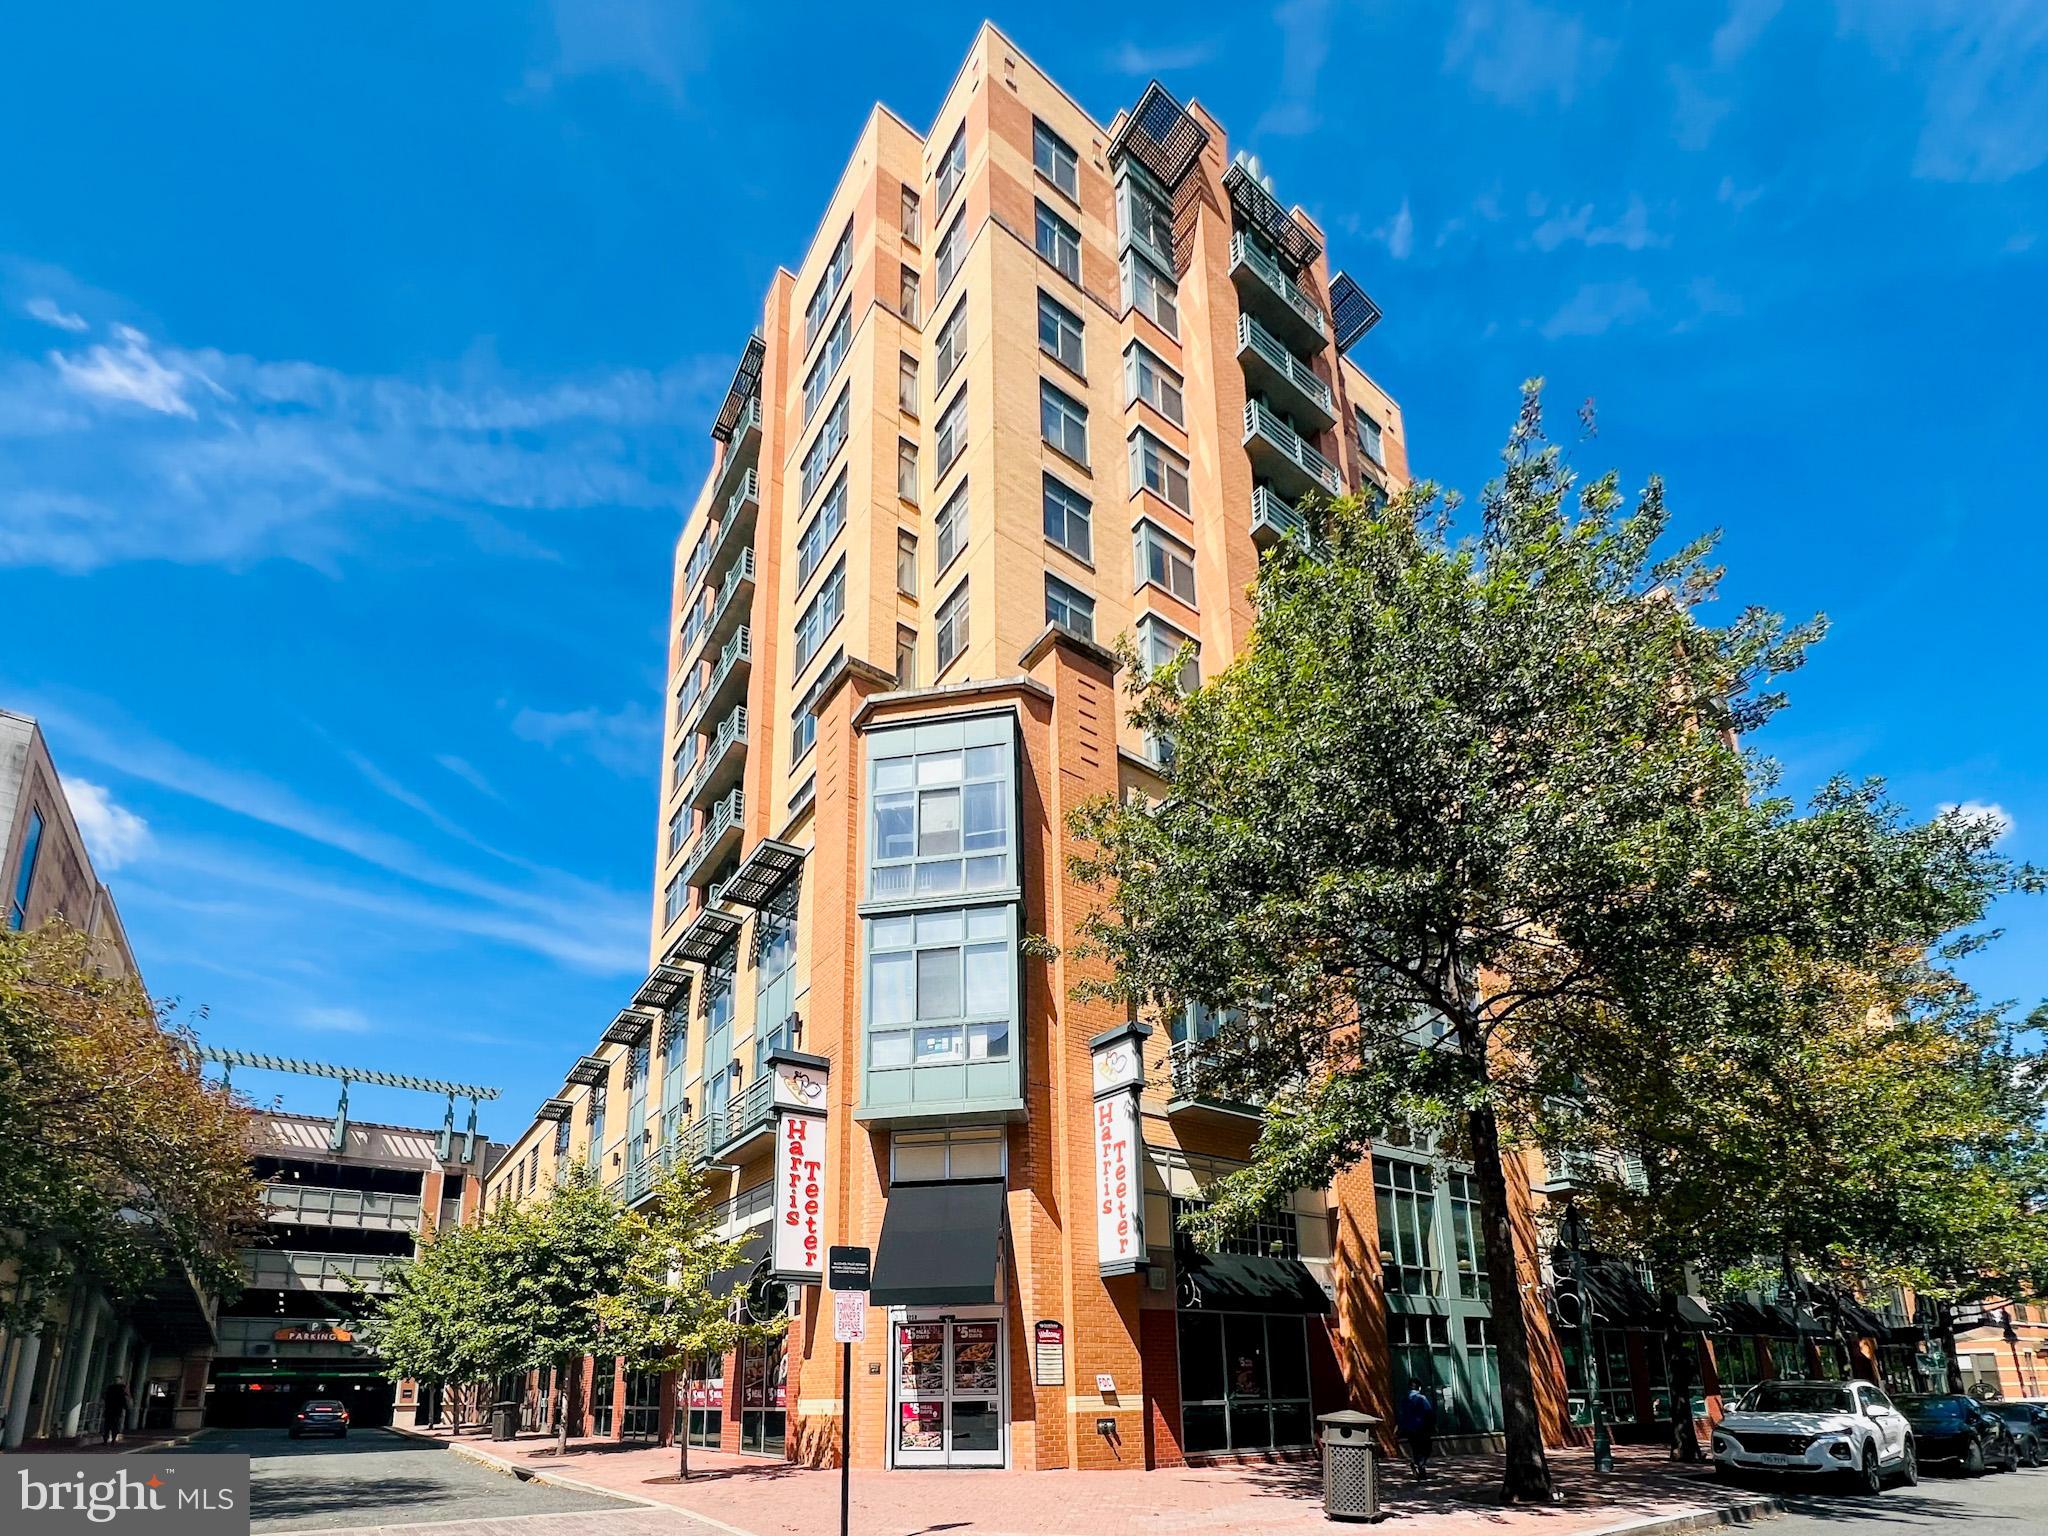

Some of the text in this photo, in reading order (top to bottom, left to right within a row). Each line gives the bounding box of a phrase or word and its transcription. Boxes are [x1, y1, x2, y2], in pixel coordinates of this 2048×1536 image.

[786, 1119, 807, 1227] Harris
[1098, 1102, 1114, 1215] Harris
[1113, 1140, 1130, 1255] Teeter
[803, 1160, 821, 1267] Teeter
[837, 1302, 862, 1311] TOWING AT
[838, 1321, 861, 1330] EXPENSE
